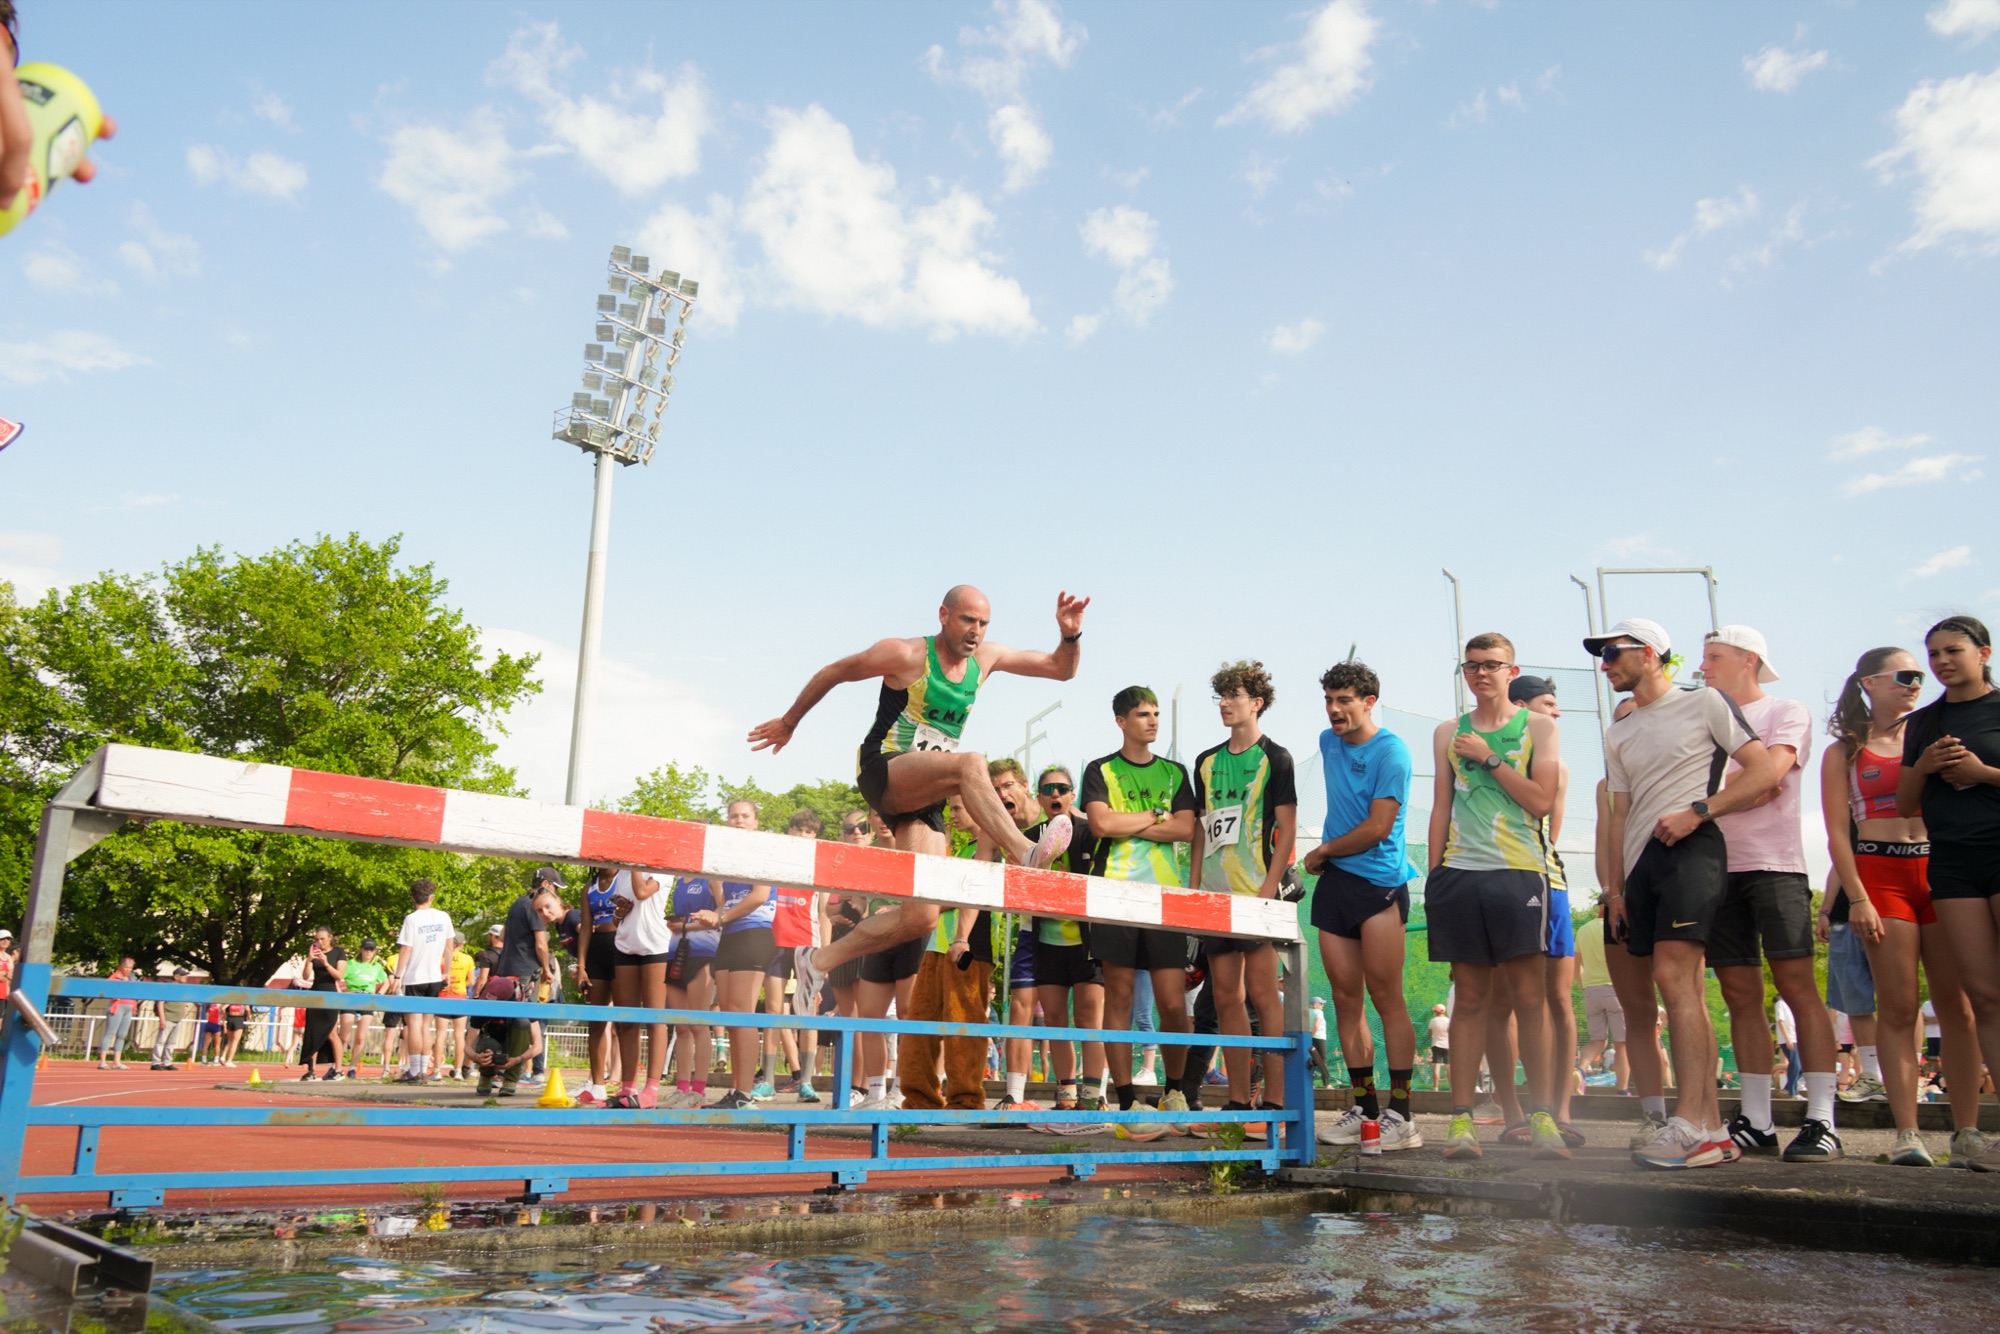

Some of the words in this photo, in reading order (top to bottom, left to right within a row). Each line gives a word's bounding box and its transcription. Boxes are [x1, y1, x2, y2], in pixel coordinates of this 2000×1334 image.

[928, 709, 965, 724] CMI
[1128, 787, 1165, 801] CMI
[1214, 789, 1247, 801] CMI
[1208, 816, 1237, 843] 167
[1886, 844, 1931, 855] NIKE
